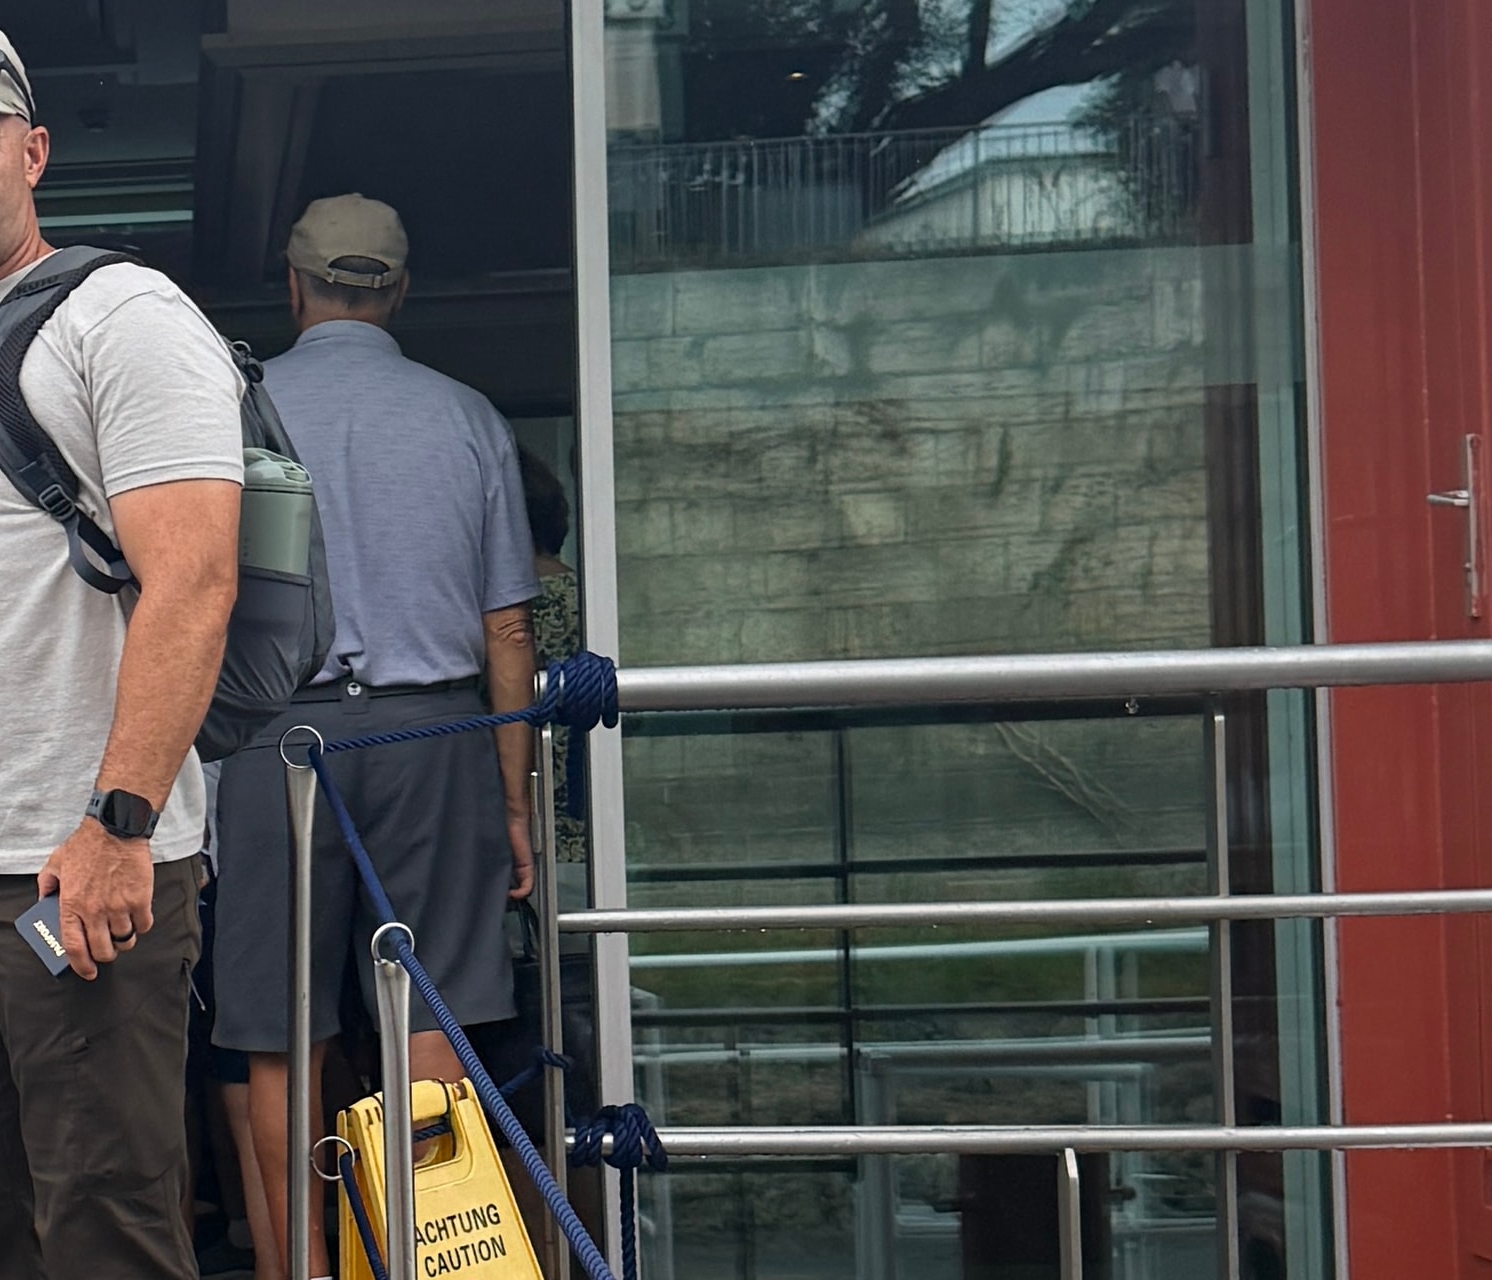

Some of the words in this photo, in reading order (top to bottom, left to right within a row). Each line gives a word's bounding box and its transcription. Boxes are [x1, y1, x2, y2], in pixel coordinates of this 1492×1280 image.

[33, 920, 66, 957] PASSPORT
[415, 1203, 501, 1248] ACHTUNG
[424, 1234, 507, 1278] CAUTION
